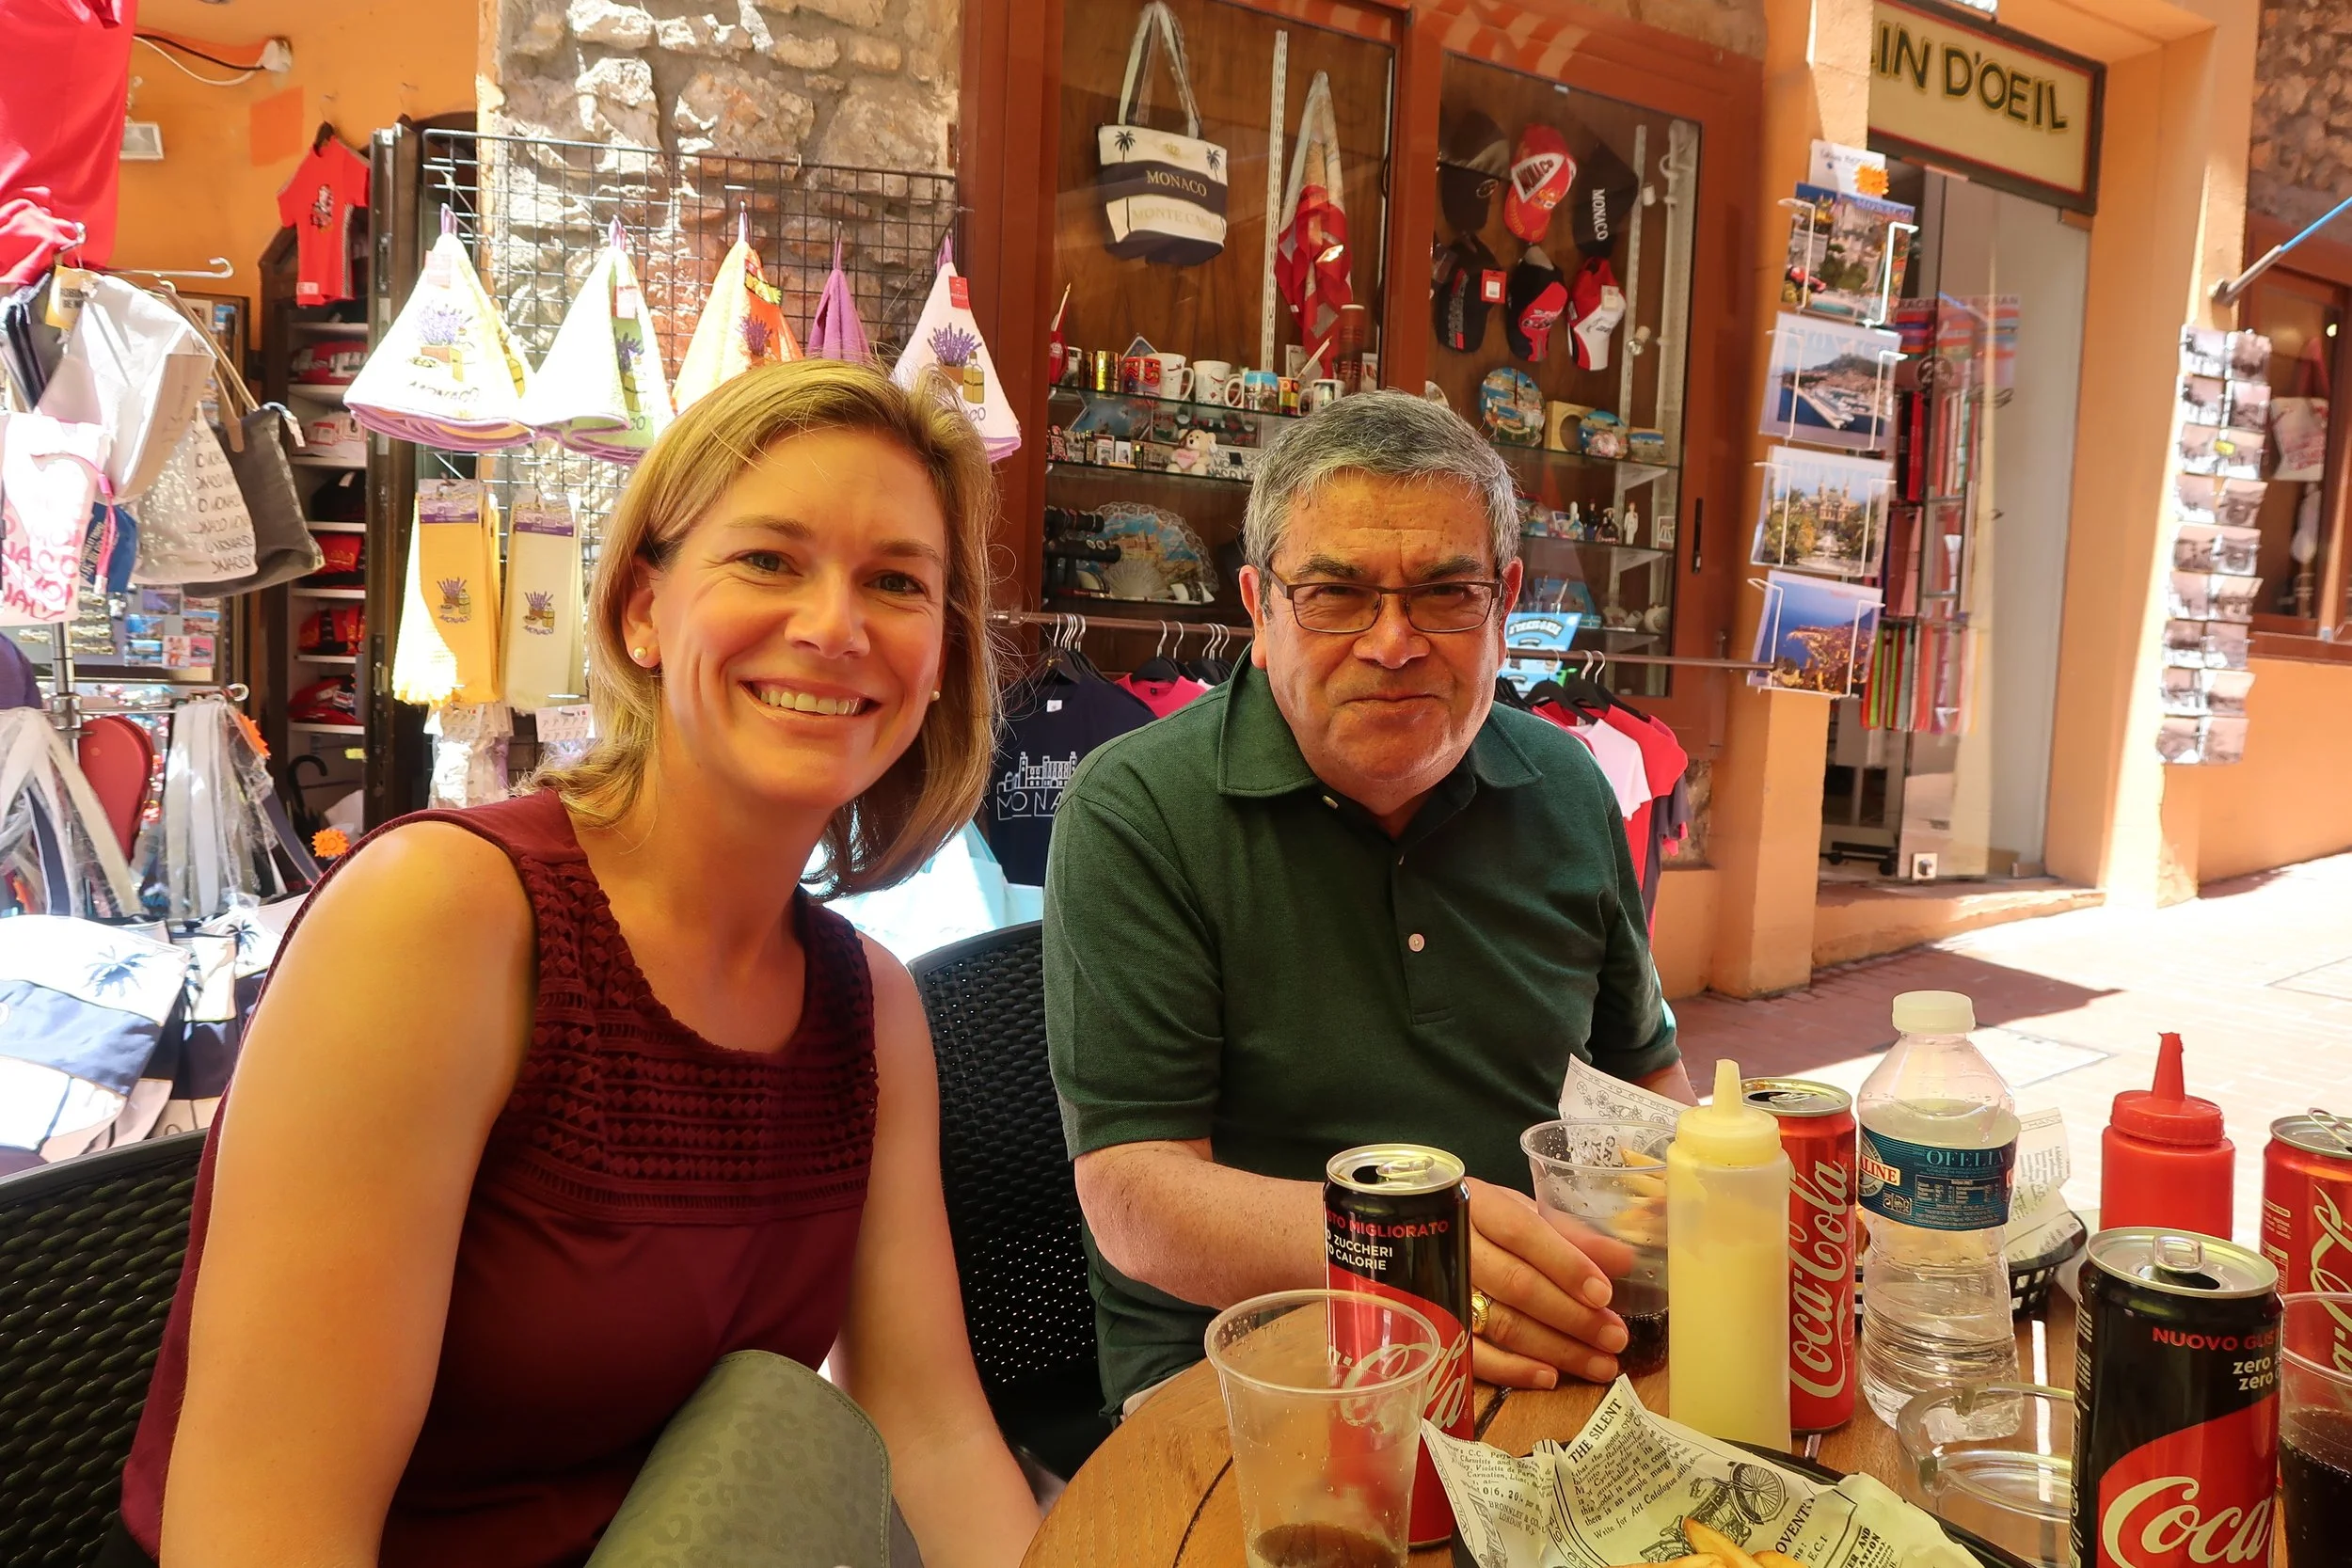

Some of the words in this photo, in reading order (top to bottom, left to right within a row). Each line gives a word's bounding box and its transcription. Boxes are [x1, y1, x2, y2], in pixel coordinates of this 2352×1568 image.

[1870, 22, 1933, 90] IN
[1944, 42, 2068, 131] D'OEIL
[1147, 170, 1207, 197] MONACO
[1516, 158, 1554, 194] MONACO
[1133, 208, 1183, 223] MONTE
[1592, 188, 1609, 242] MONACO
[523, 625, 554, 636] MONACO
[1349, 1220, 1449, 1239] MIGLIORATO
[1333, 1234, 1393, 1258] ZUCCHERI
[1335, 1248, 1387, 1271] CALORIE
[1788, 1160, 1848, 1399] Coca-Cola
[2152, 1326, 2239, 1352] NUOVO
[2233, 1356, 2271, 1375] zero
[2238, 1371, 2274, 1391] zero
[1568, 1440, 1593, 1464] THE
[1589, 1399, 1622, 1440] SILENT
[1592, 1452, 1602, 1463] the
[1605, 1431, 1621, 1450] motor
[1460, 1455, 1490, 1464] Chemists
[1517, 1462, 1537, 1472] Stores
[1587, 1471, 1599, 1482] into
[1604, 1459, 1614, 1469] the
[1597, 1465, 1629, 1497] remarkable
[1632, 1456, 1641, 1465] as
[1643, 1445, 1653, 1455] its
[1594, 1466, 1614, 1486] Cycle,
[1581, 1502, 1595, 1516] this
[1615, 1483, 1623, 1493] is
[1624, 1468, 1640, 1485] used
[1641, 1461, 1649, 1471] in
[1488, 1500, 1523, 1518] BRONNLEY
[1585, 1513, 1601, 1526] there
[1604, 1506, 1612, 1515] is
[1615, 1497, 1624, 1506] an
[1628, 1478, 1647, 1497] ample
[1594, 1525, 1614, 1539] Write
[1616, 1516, 1628, 1528] for
[1630, 1502, 1644, 1516] Art
[1644, 1478, 1677, 1504] Catalogue
[1499, 1513, 1523, 1531] LONDON,
[1857, 1527, 1871, 1549] AND
